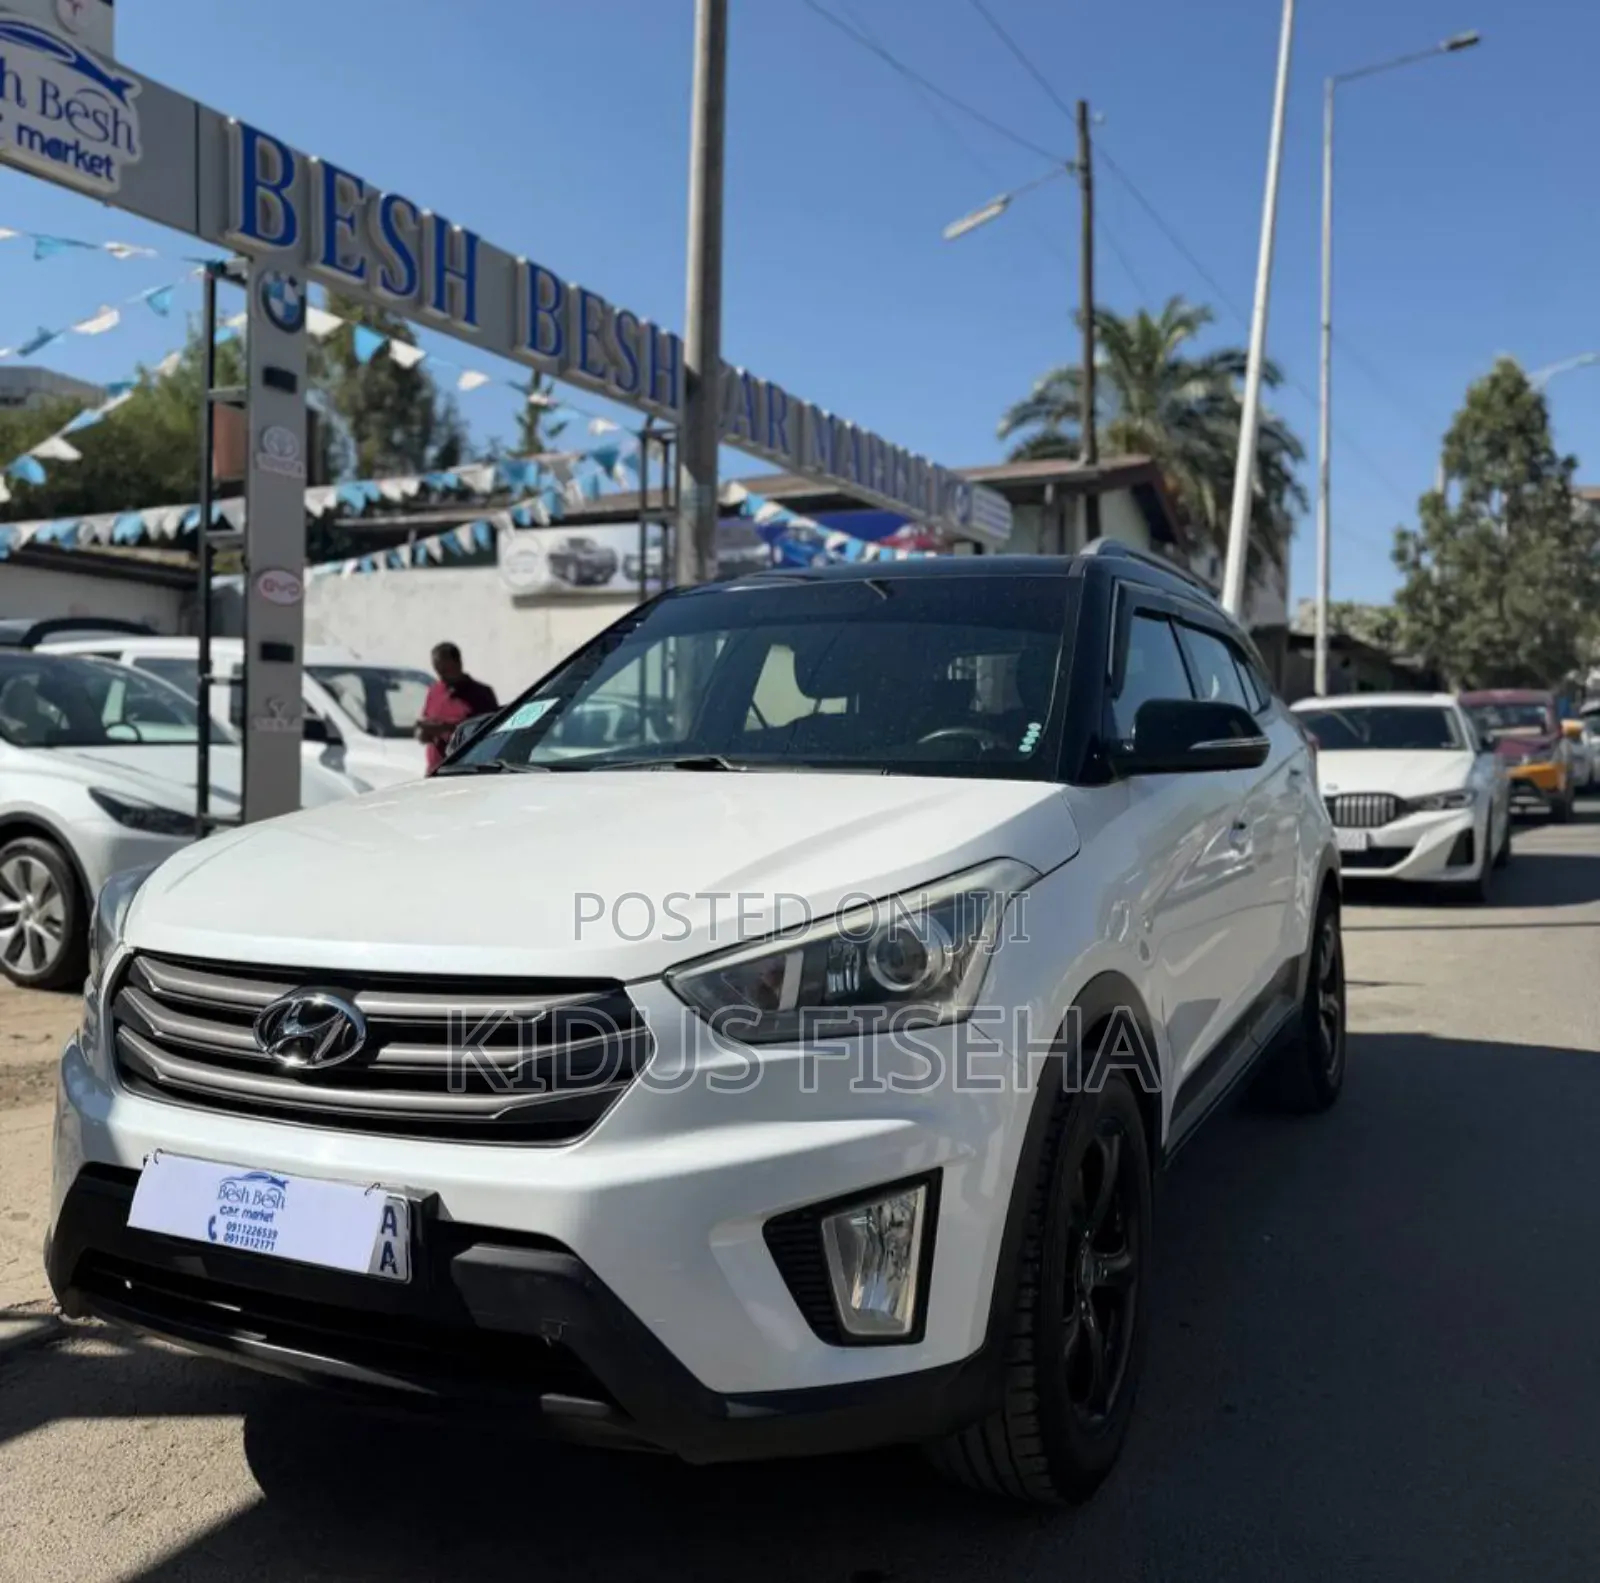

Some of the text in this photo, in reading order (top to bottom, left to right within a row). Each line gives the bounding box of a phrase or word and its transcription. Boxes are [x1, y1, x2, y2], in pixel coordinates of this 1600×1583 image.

[38, 75, 136, 155] Besh
[17, 122, 114, 182] market
[237, 119, 480, 327] BESH
[527, 262, 678, 409] BESH
[720, 368, 791, 455] AR
[217, 1181, 286, 1210] Besh Besh
[219, 1205, 275, 1222] car market
